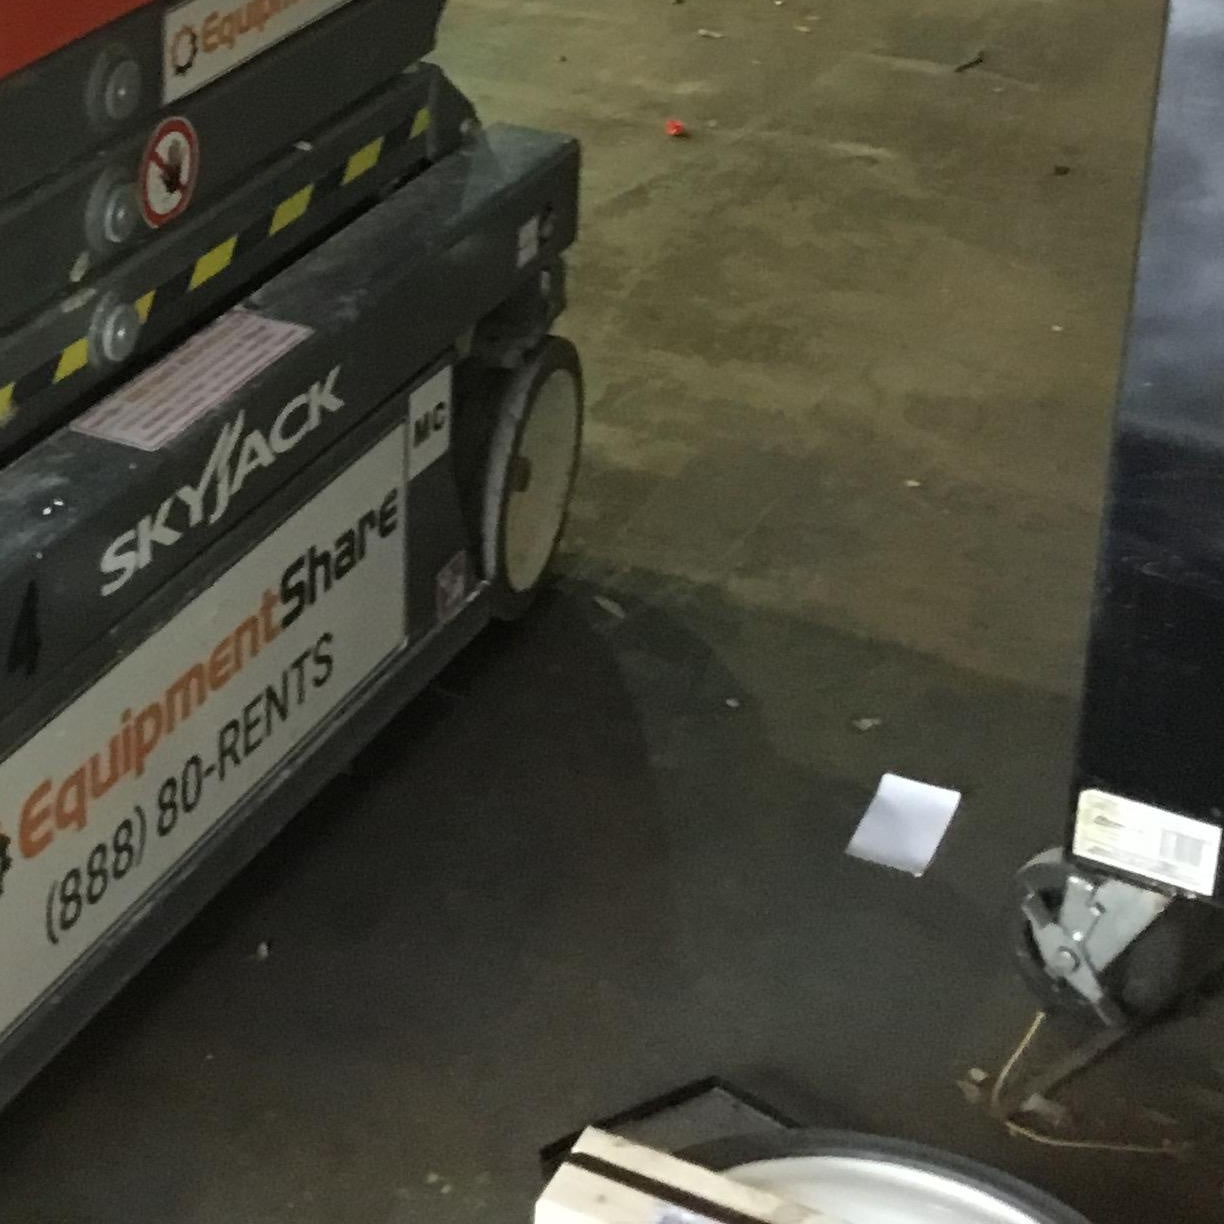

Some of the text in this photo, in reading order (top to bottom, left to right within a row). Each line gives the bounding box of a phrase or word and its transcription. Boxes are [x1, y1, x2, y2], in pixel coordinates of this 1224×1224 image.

[99, 364, 345, 597] SKYJACK
[413, 401, 446, 449] MC
[17, 488, 399, 859] EquipmentShare
[45, 632, 334, 945] (888) 80-RENTS
